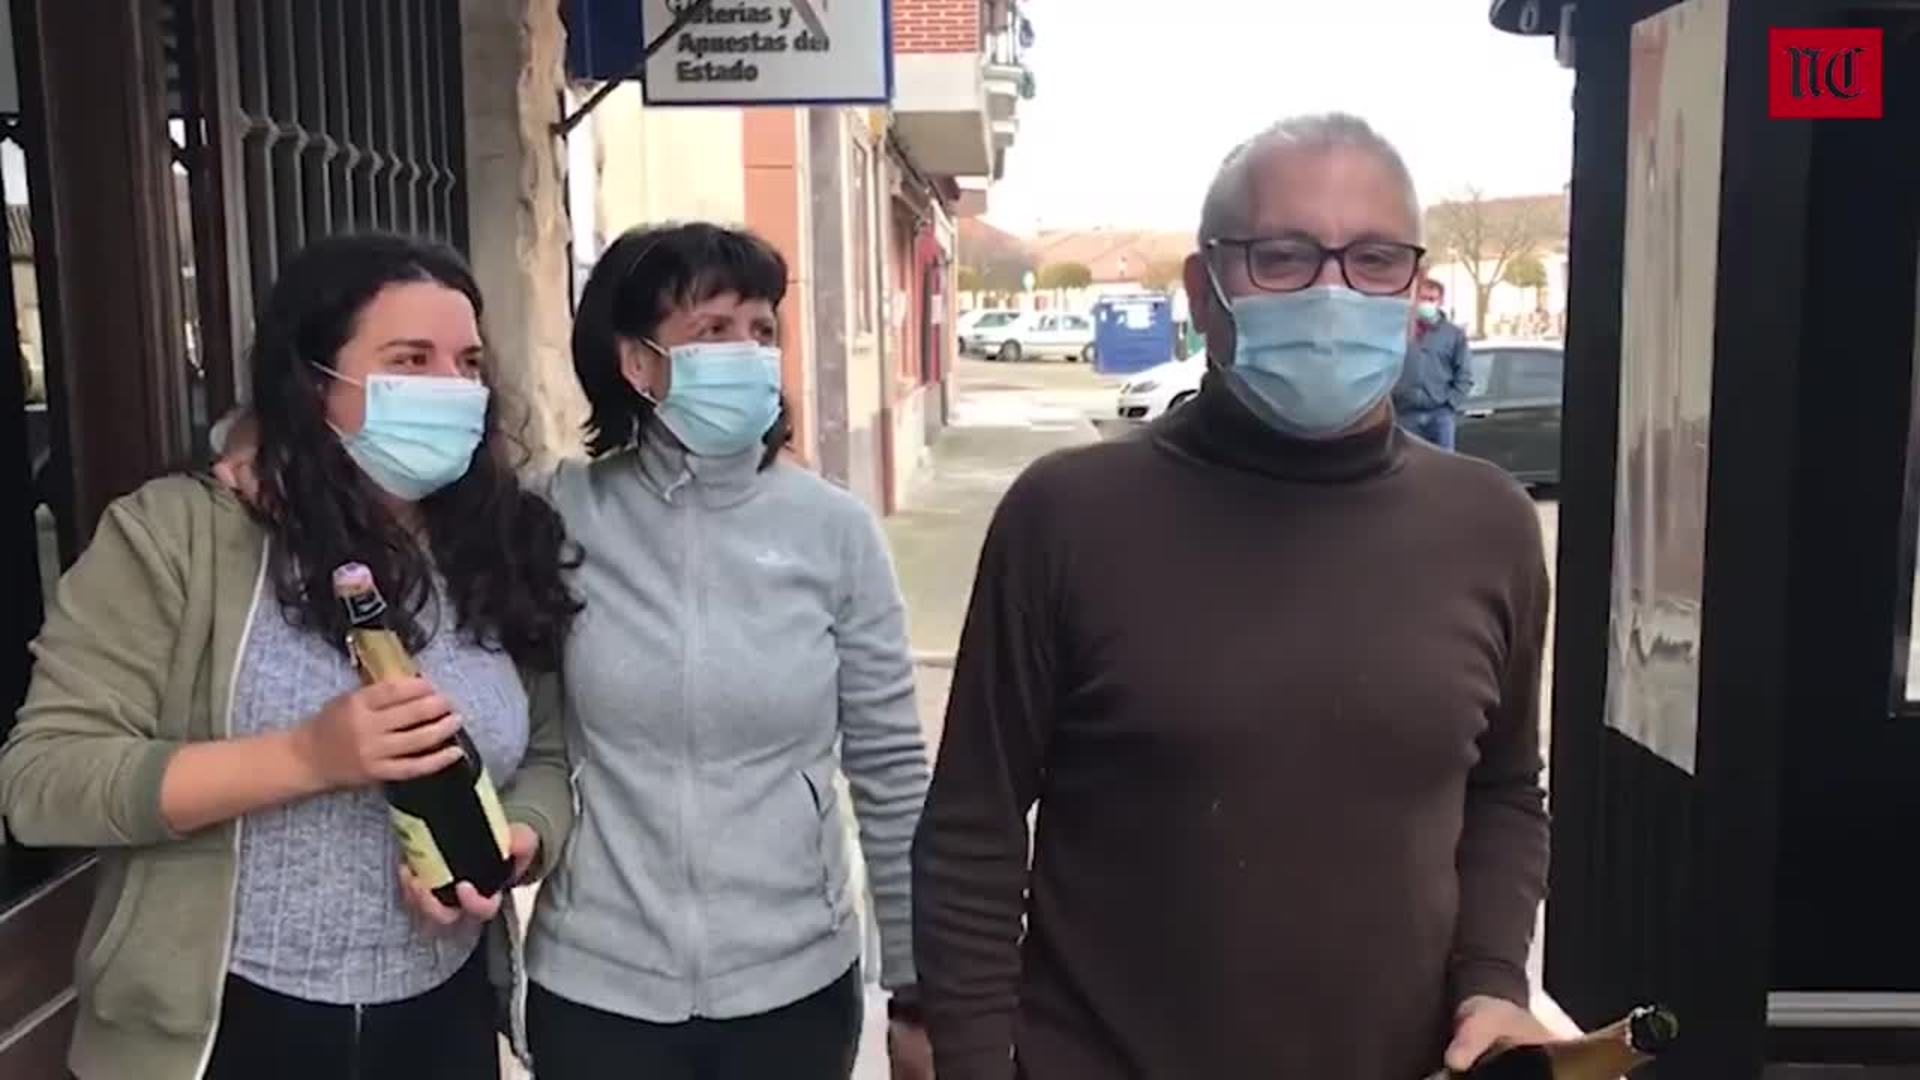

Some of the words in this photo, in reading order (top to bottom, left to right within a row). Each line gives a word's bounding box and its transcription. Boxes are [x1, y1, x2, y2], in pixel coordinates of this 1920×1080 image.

[778, 7, 792, 29] y
[678, 32, 788, 58] Apuestas
[677, 60, 758, 82] Estado
